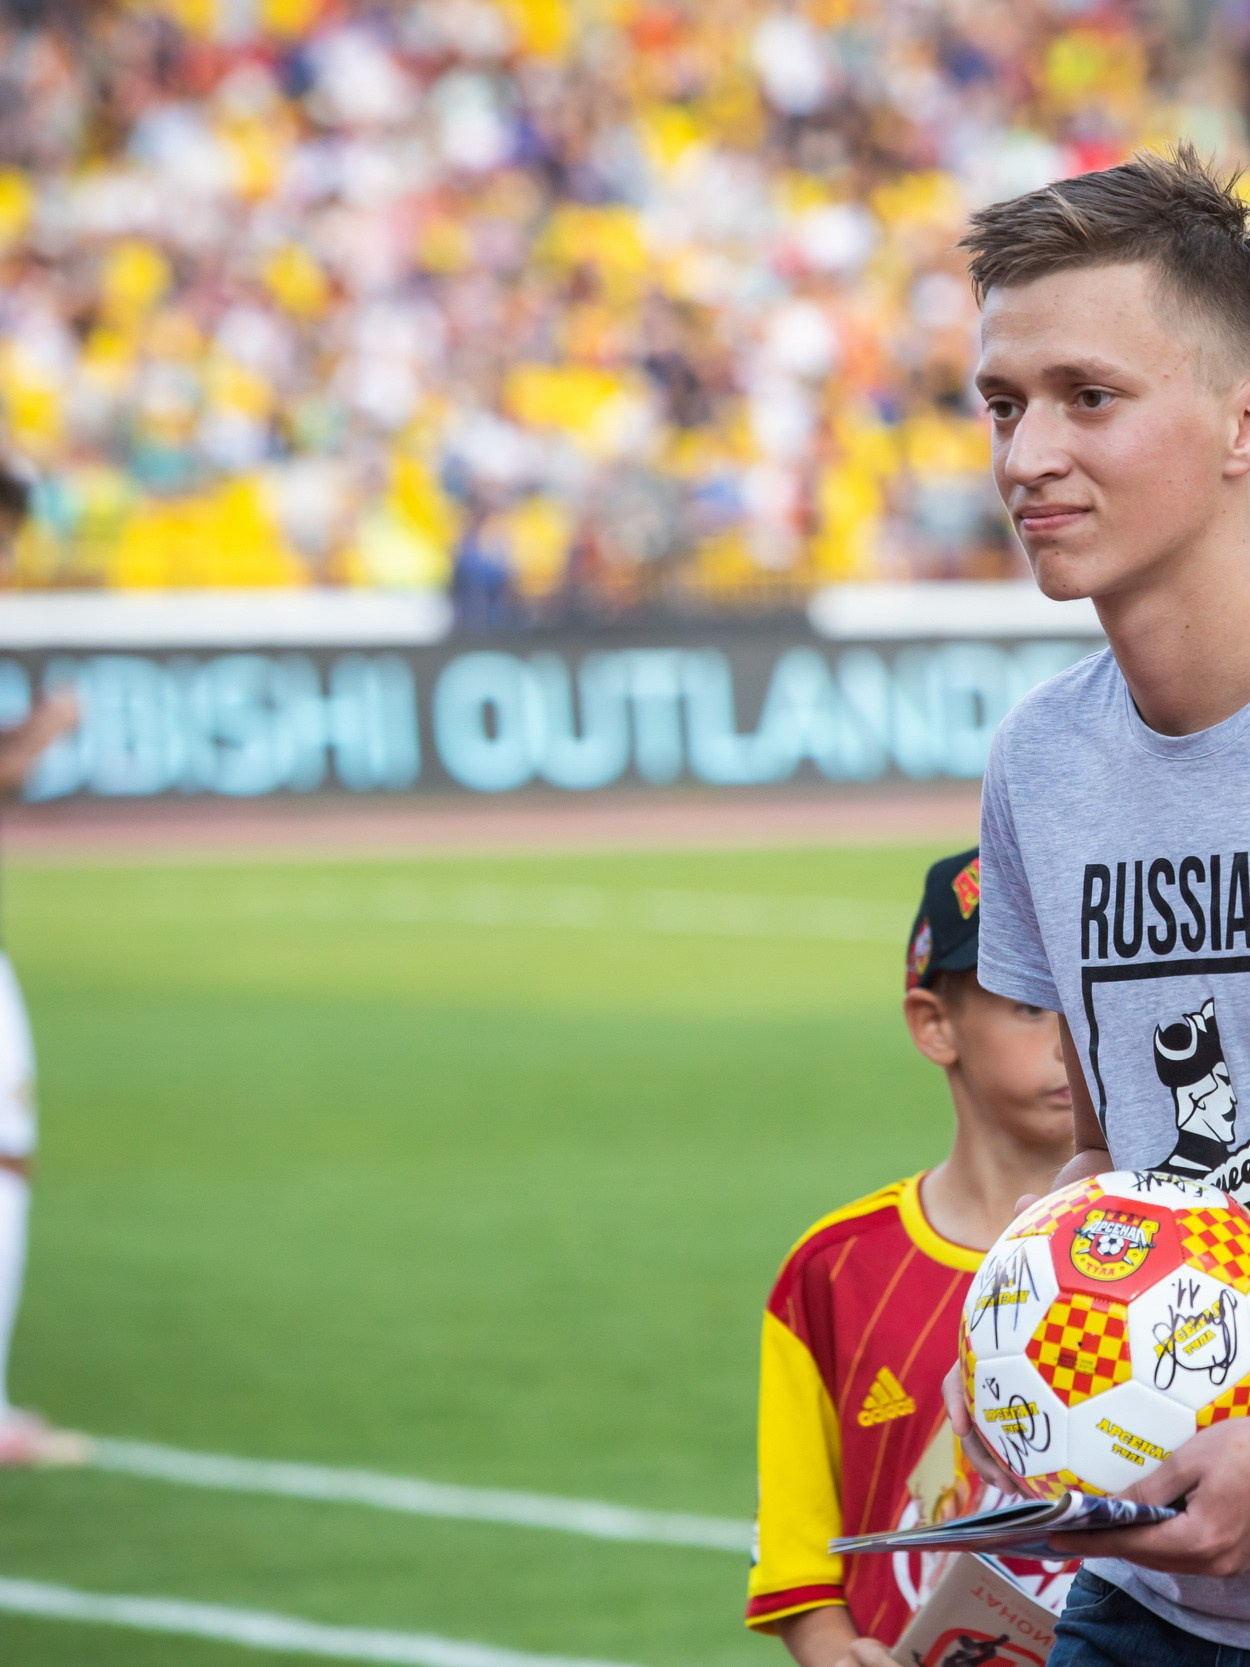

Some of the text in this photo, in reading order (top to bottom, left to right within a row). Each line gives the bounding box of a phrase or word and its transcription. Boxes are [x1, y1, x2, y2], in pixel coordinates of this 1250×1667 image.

[432, 643, 1092, 791] OUTLAND
[1080, 1220, 1147, 1249] АРСЕНАЛ
[1086, 1262, 1116, 1276] ТУЛА
[857, 1396, 917, 1427] adidas
[1111, 1443, 1145, 1467] ТУЛА
[971, 1586, 1053, 1647] ИОНАТ
